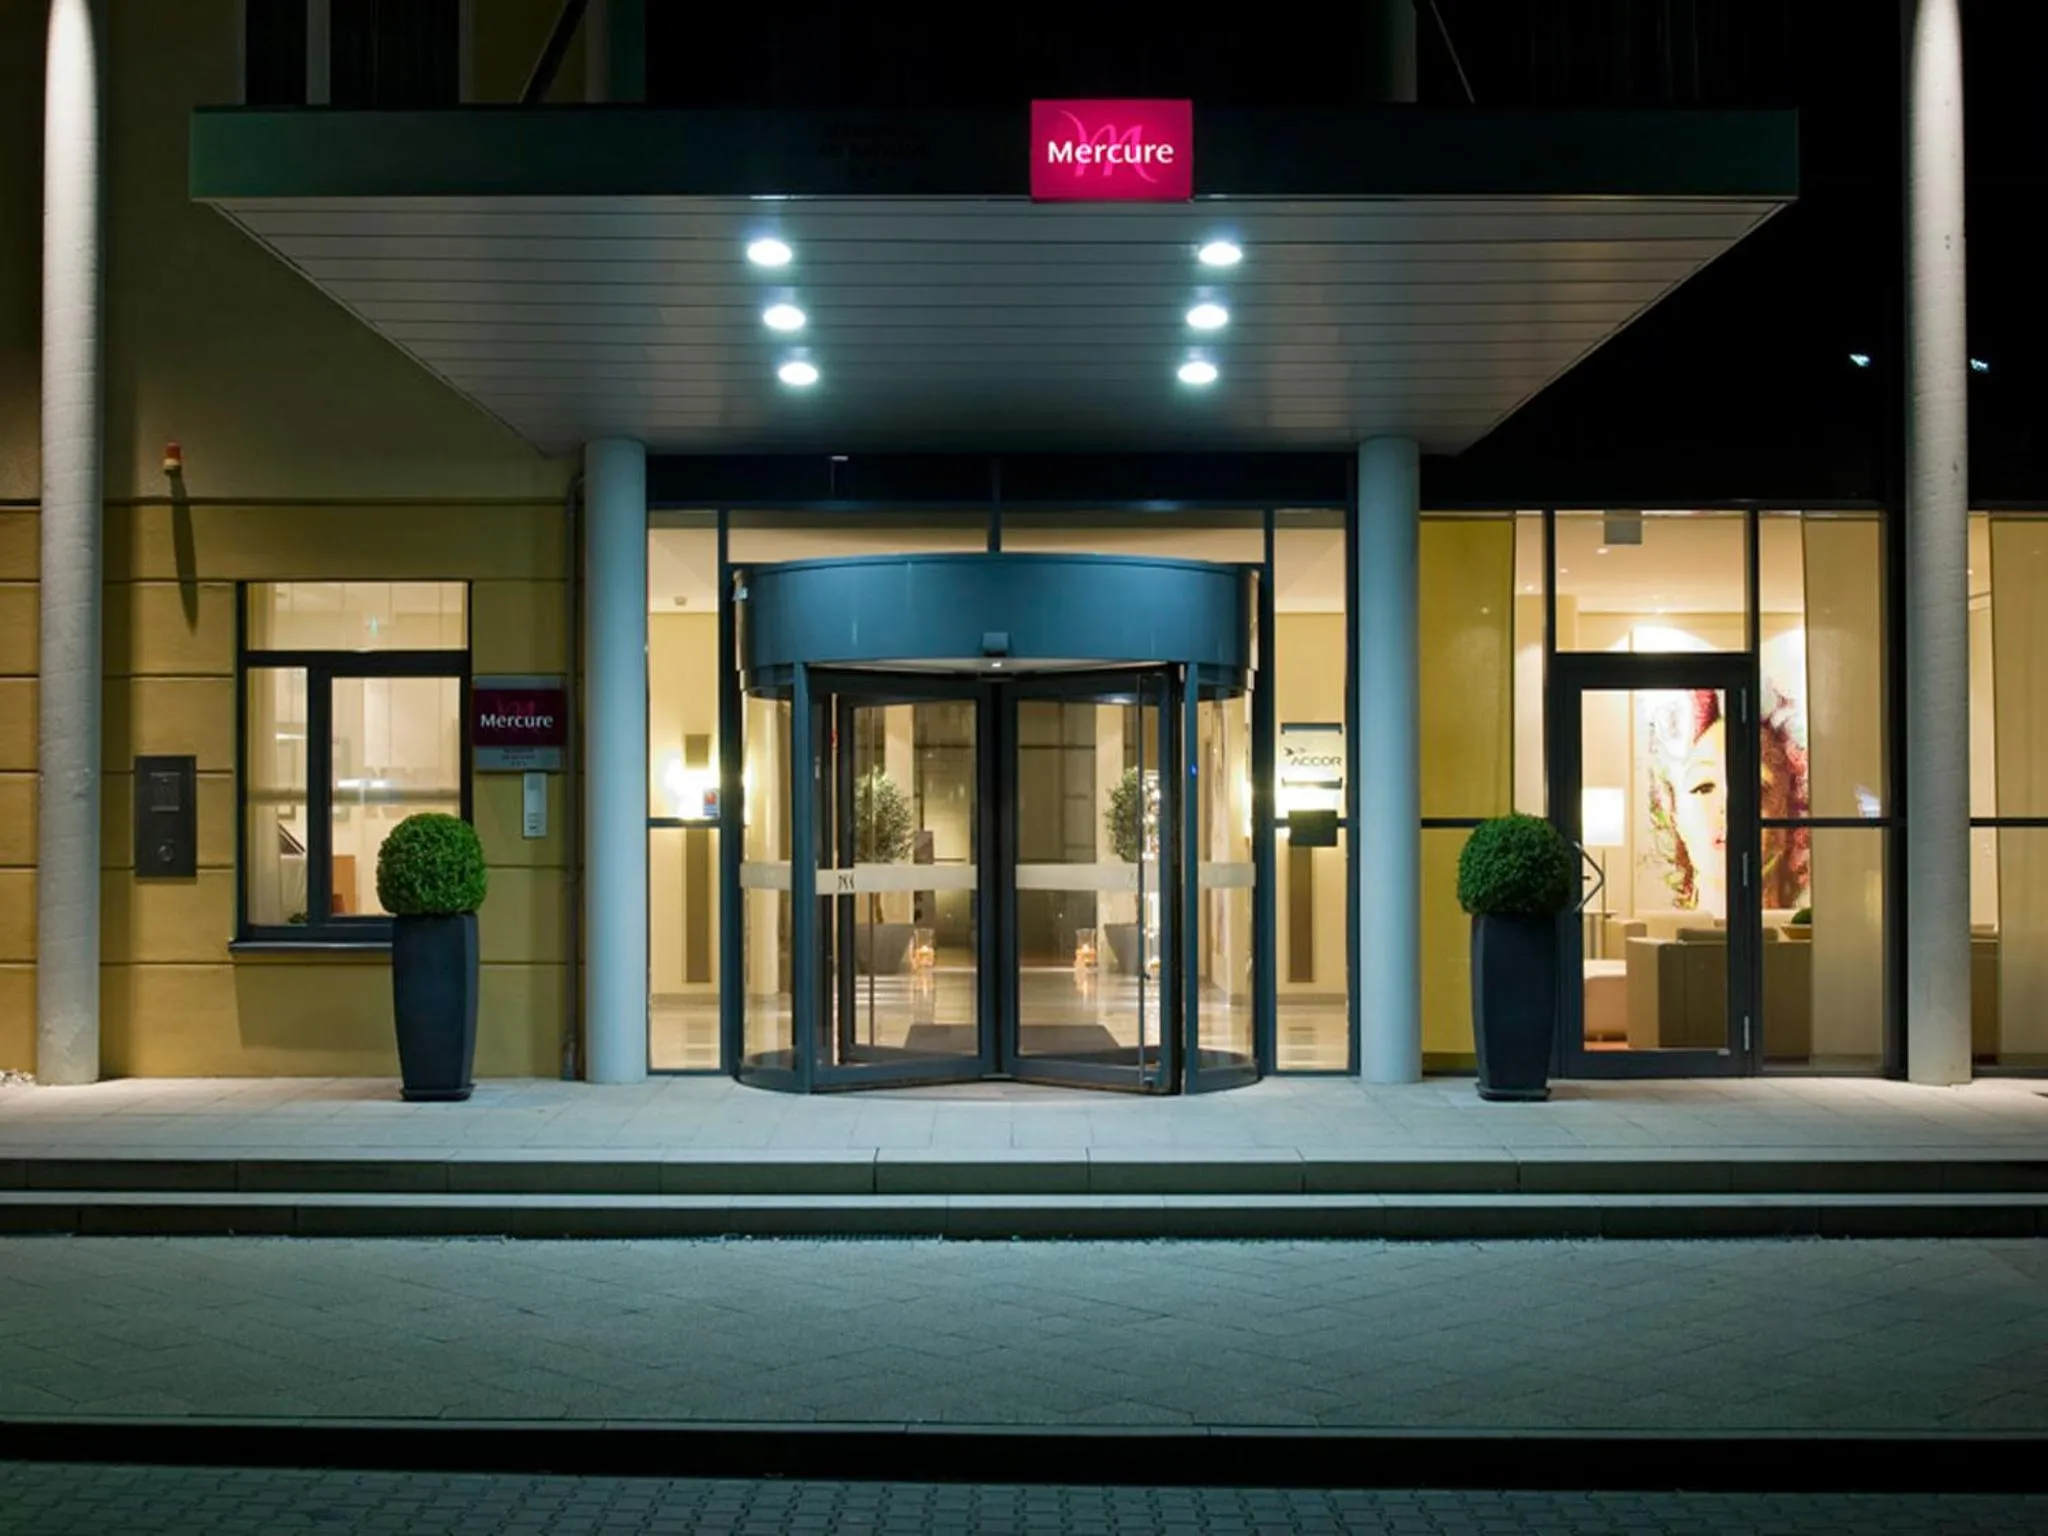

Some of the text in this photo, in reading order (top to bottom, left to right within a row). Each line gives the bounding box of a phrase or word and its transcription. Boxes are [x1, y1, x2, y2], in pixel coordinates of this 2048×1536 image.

[1047, 140, 1175, 164] Mercure
[480, 713, 554, 728] Mercure
[1290, 755, 1342, 767] ACCOR
